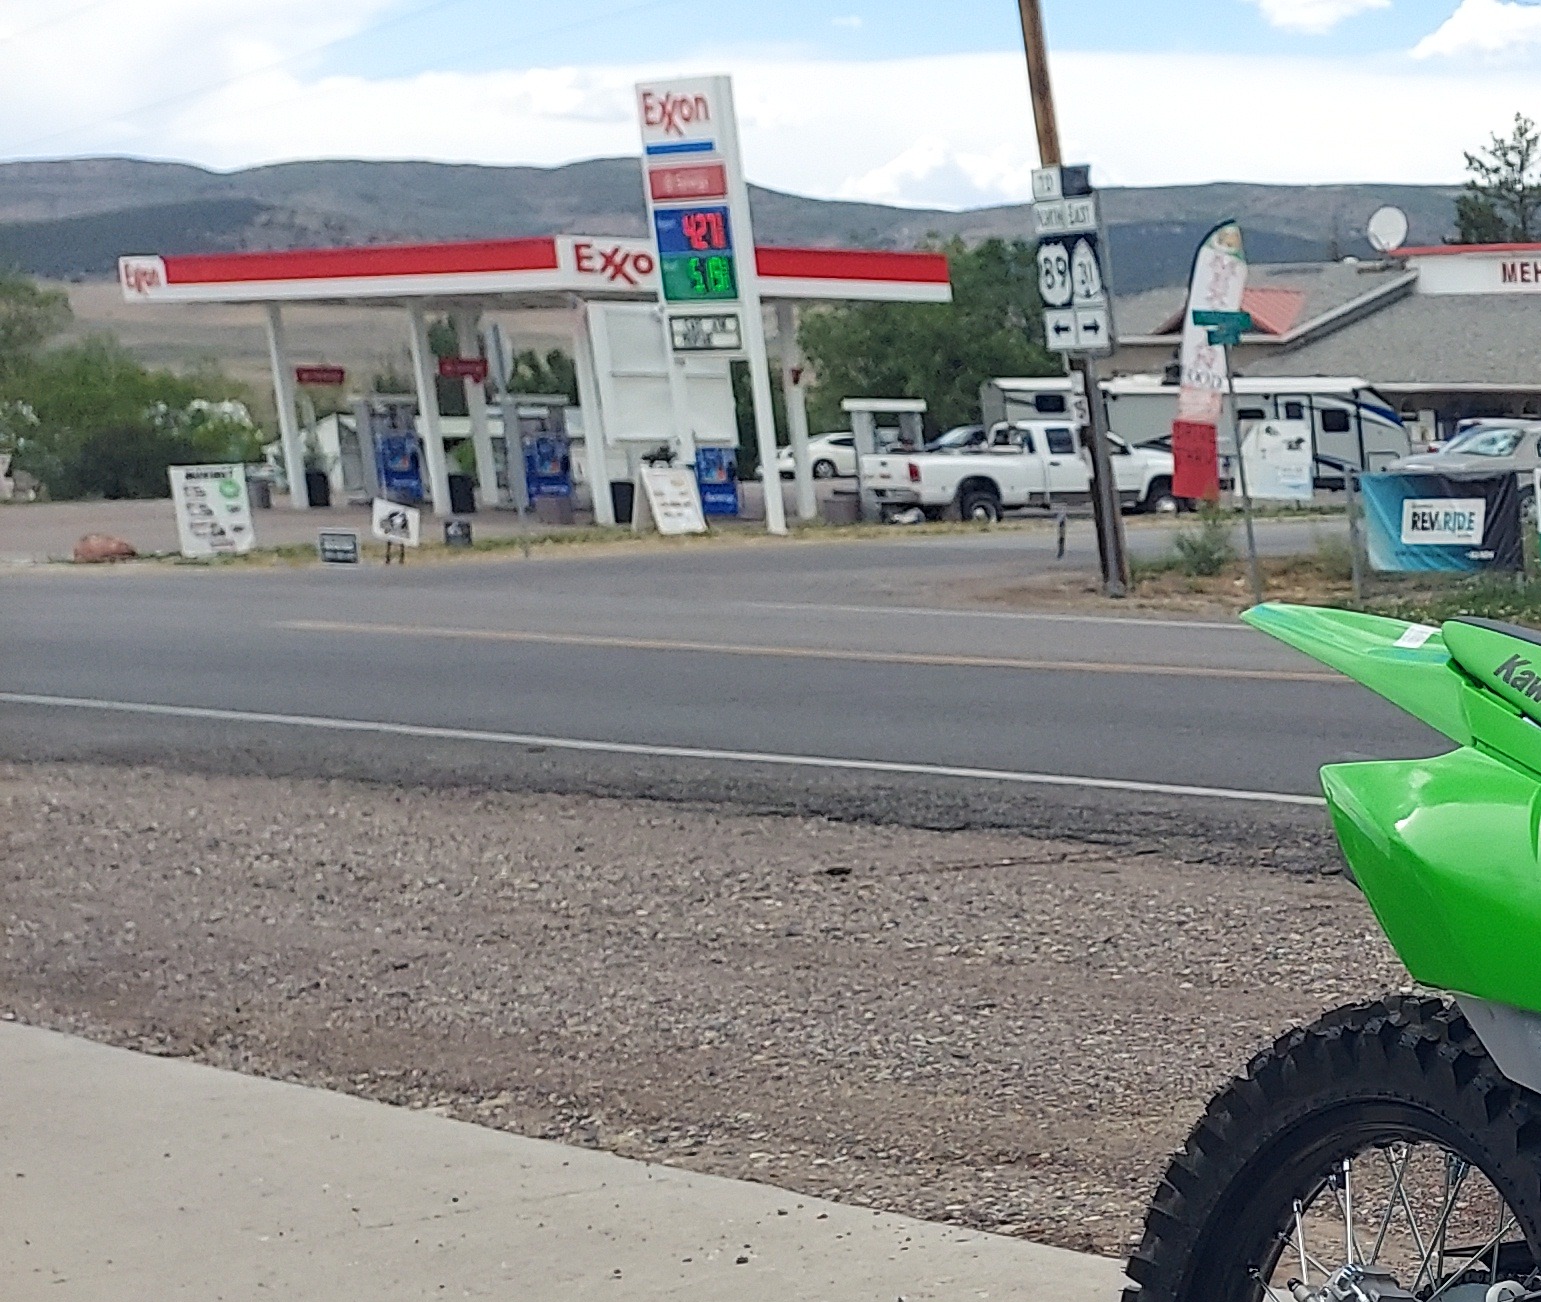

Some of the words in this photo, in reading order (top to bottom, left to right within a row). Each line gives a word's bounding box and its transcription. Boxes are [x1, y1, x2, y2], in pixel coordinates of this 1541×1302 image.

[574, 244, 654, 286] Exxo
[1043, 256, 1067, 290] 89
[1078, 261, 1094, 286] 31
